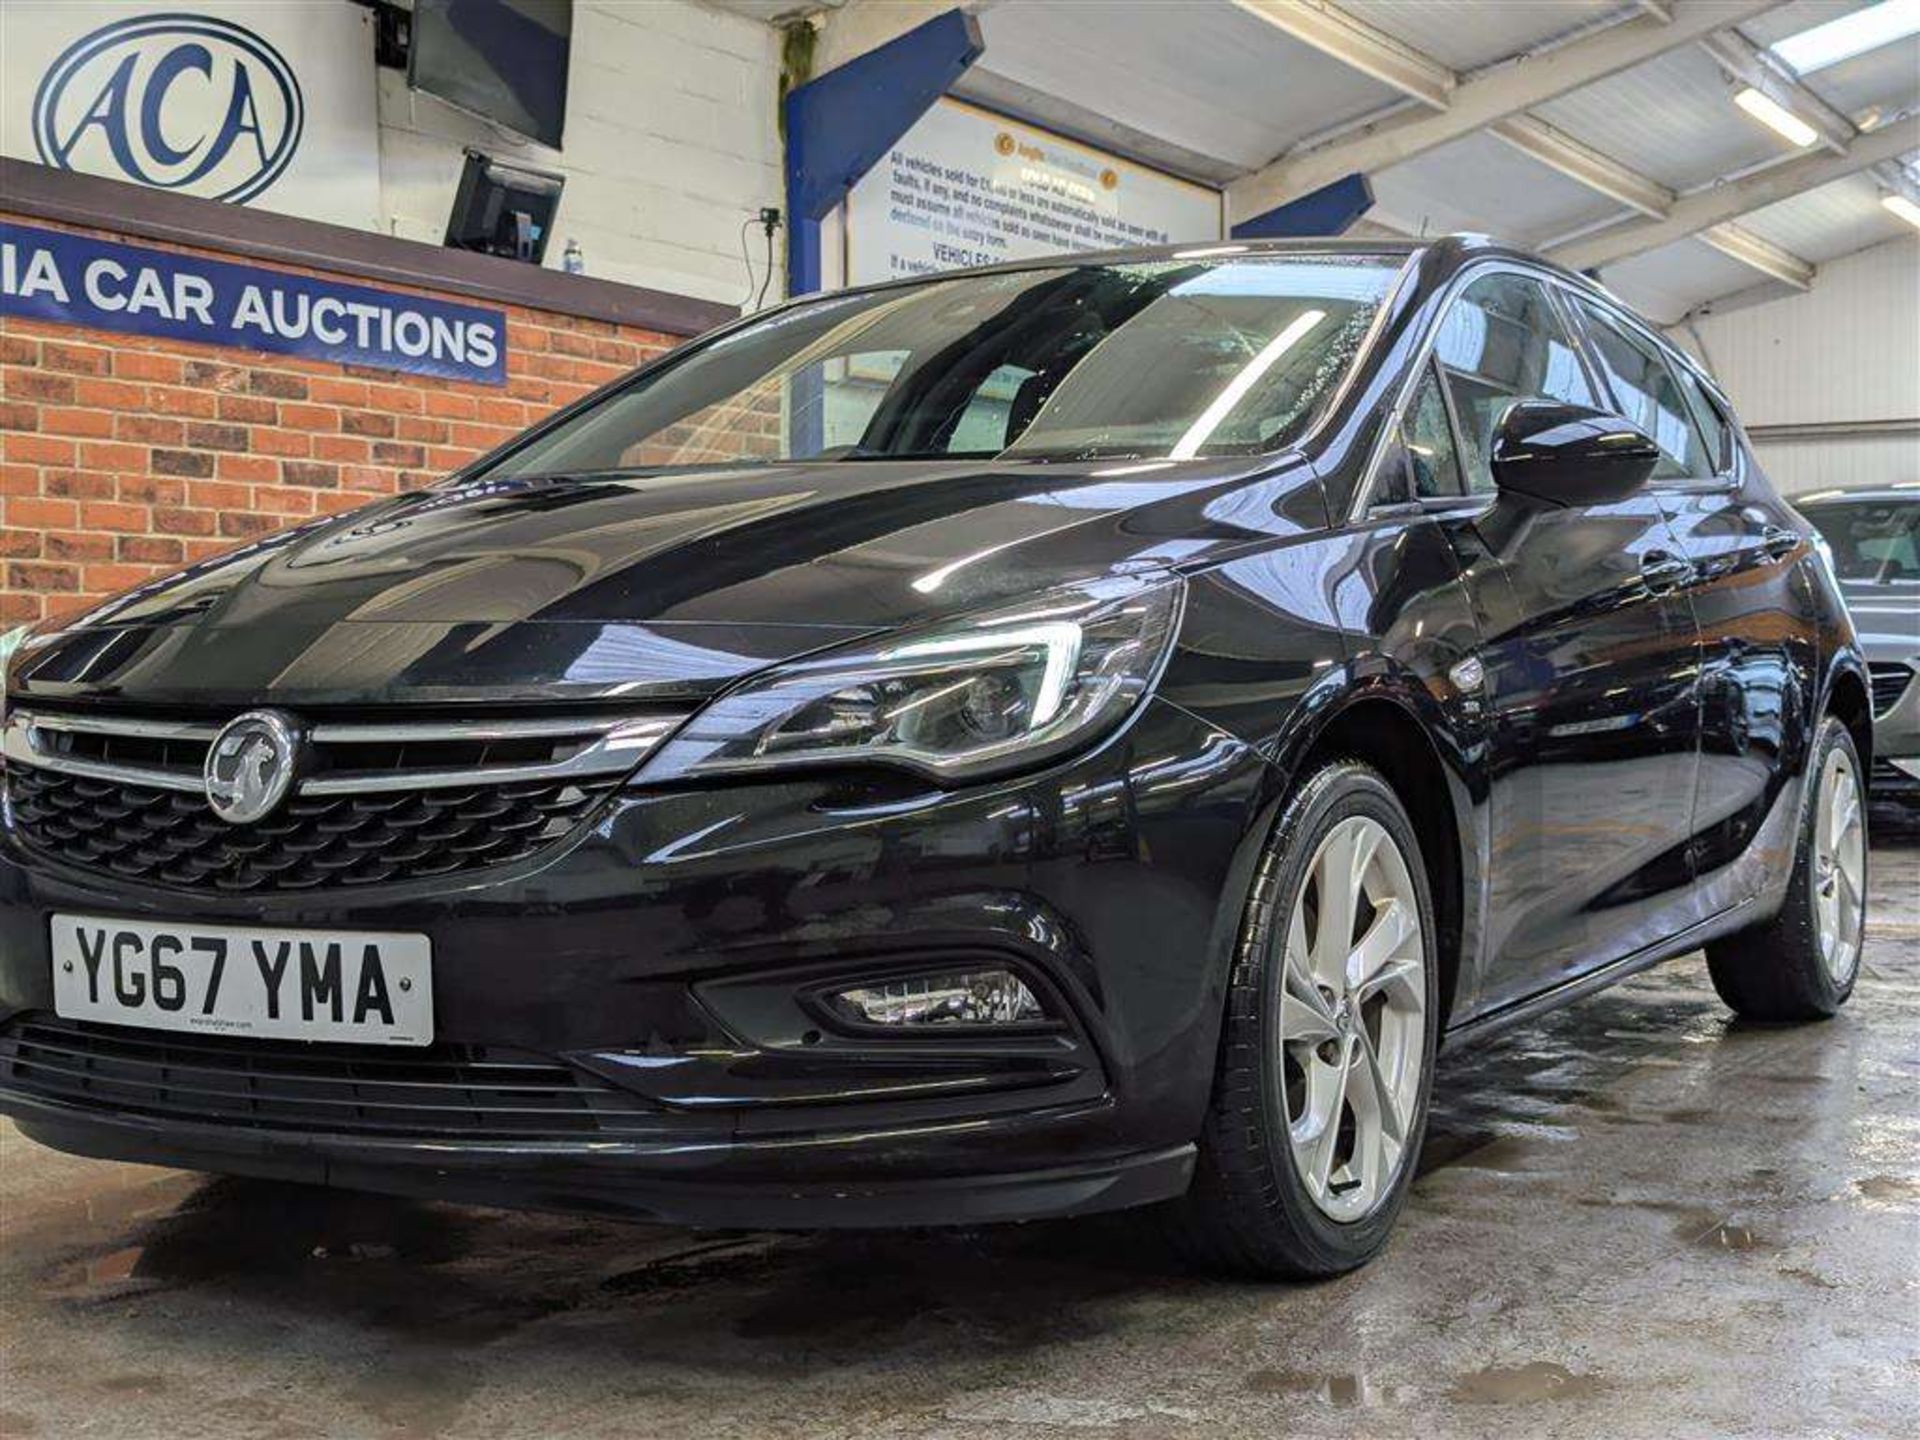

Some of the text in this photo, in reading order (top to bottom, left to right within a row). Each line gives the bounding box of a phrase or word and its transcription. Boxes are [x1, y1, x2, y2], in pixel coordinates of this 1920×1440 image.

[60, 43, 270, 188] ACA
[890, 188, 913, 206] must
[916, 197, 949, 217] assume
[1002, 219, 1018, 235] sold
[891, 150, 902, 164] All
[906, 155, 941, 177] vehicles
[945, 166, 963, 183] sold
[966, 173, 976, 186] for
[1019, 191, 1034, 205] less
[1051, 199, 1097, 225] automatically
[893, 168, 922, 189] faults,
[952, 188, 968, 203] and
[971, 195, 981, 206] no
[984, 197, 1026, 221] complaints
[1029, 210, 1072, 232] whatsoever
[1074, 223, 1091, 238] shall
[933, 240, 989, 271] VEHICLES
[84, 258, 215, 325] CAR
[231, 285, 498, 367] AUCTIONS
[76, 927, 395, 1025] YG67 YMA
